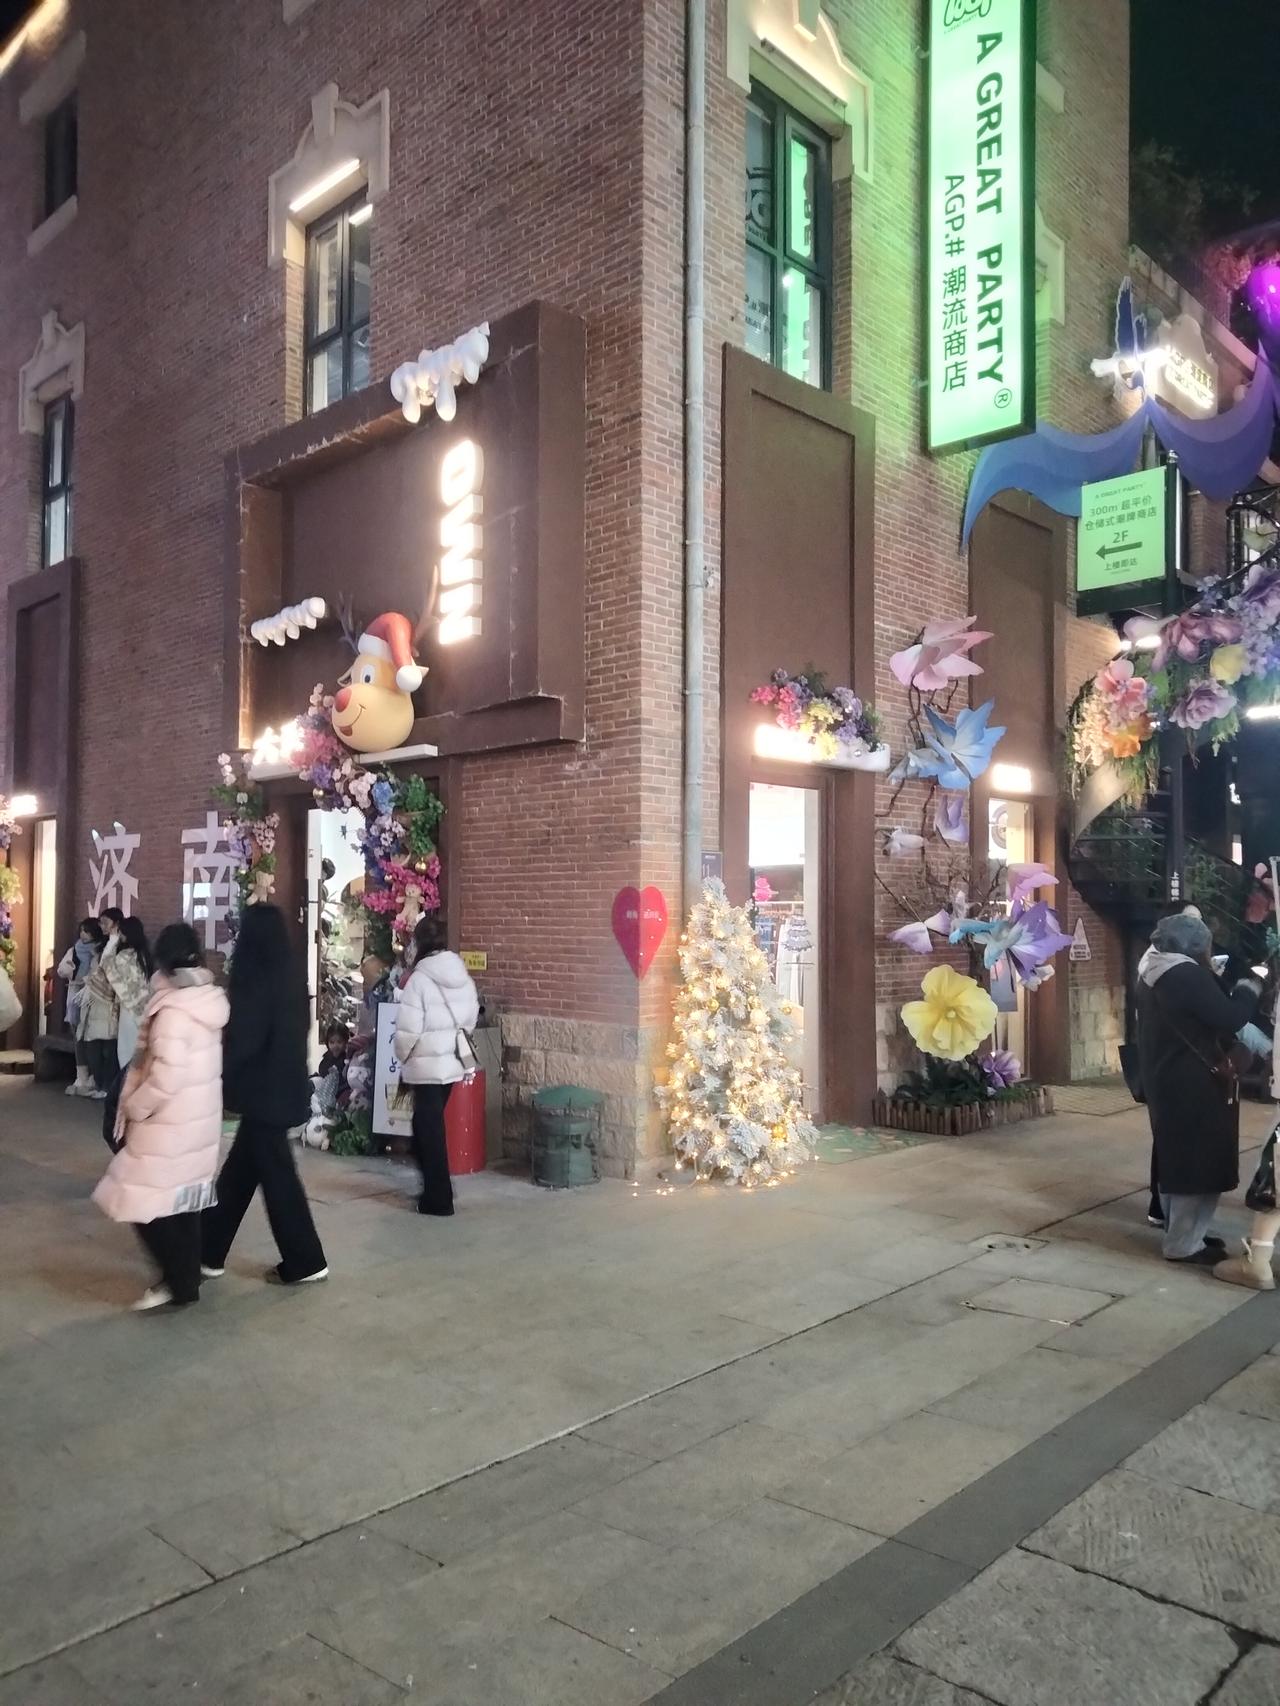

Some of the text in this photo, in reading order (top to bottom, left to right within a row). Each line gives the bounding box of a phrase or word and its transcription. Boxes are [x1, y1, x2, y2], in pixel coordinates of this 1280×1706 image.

[976, 31, 1004, 383] A GREAT PARTY
[942, 265, 968, 392] 潮流商店
[1090, 504, 1118, 516] 300m
[1112, 530, 1129, 544] 2F
